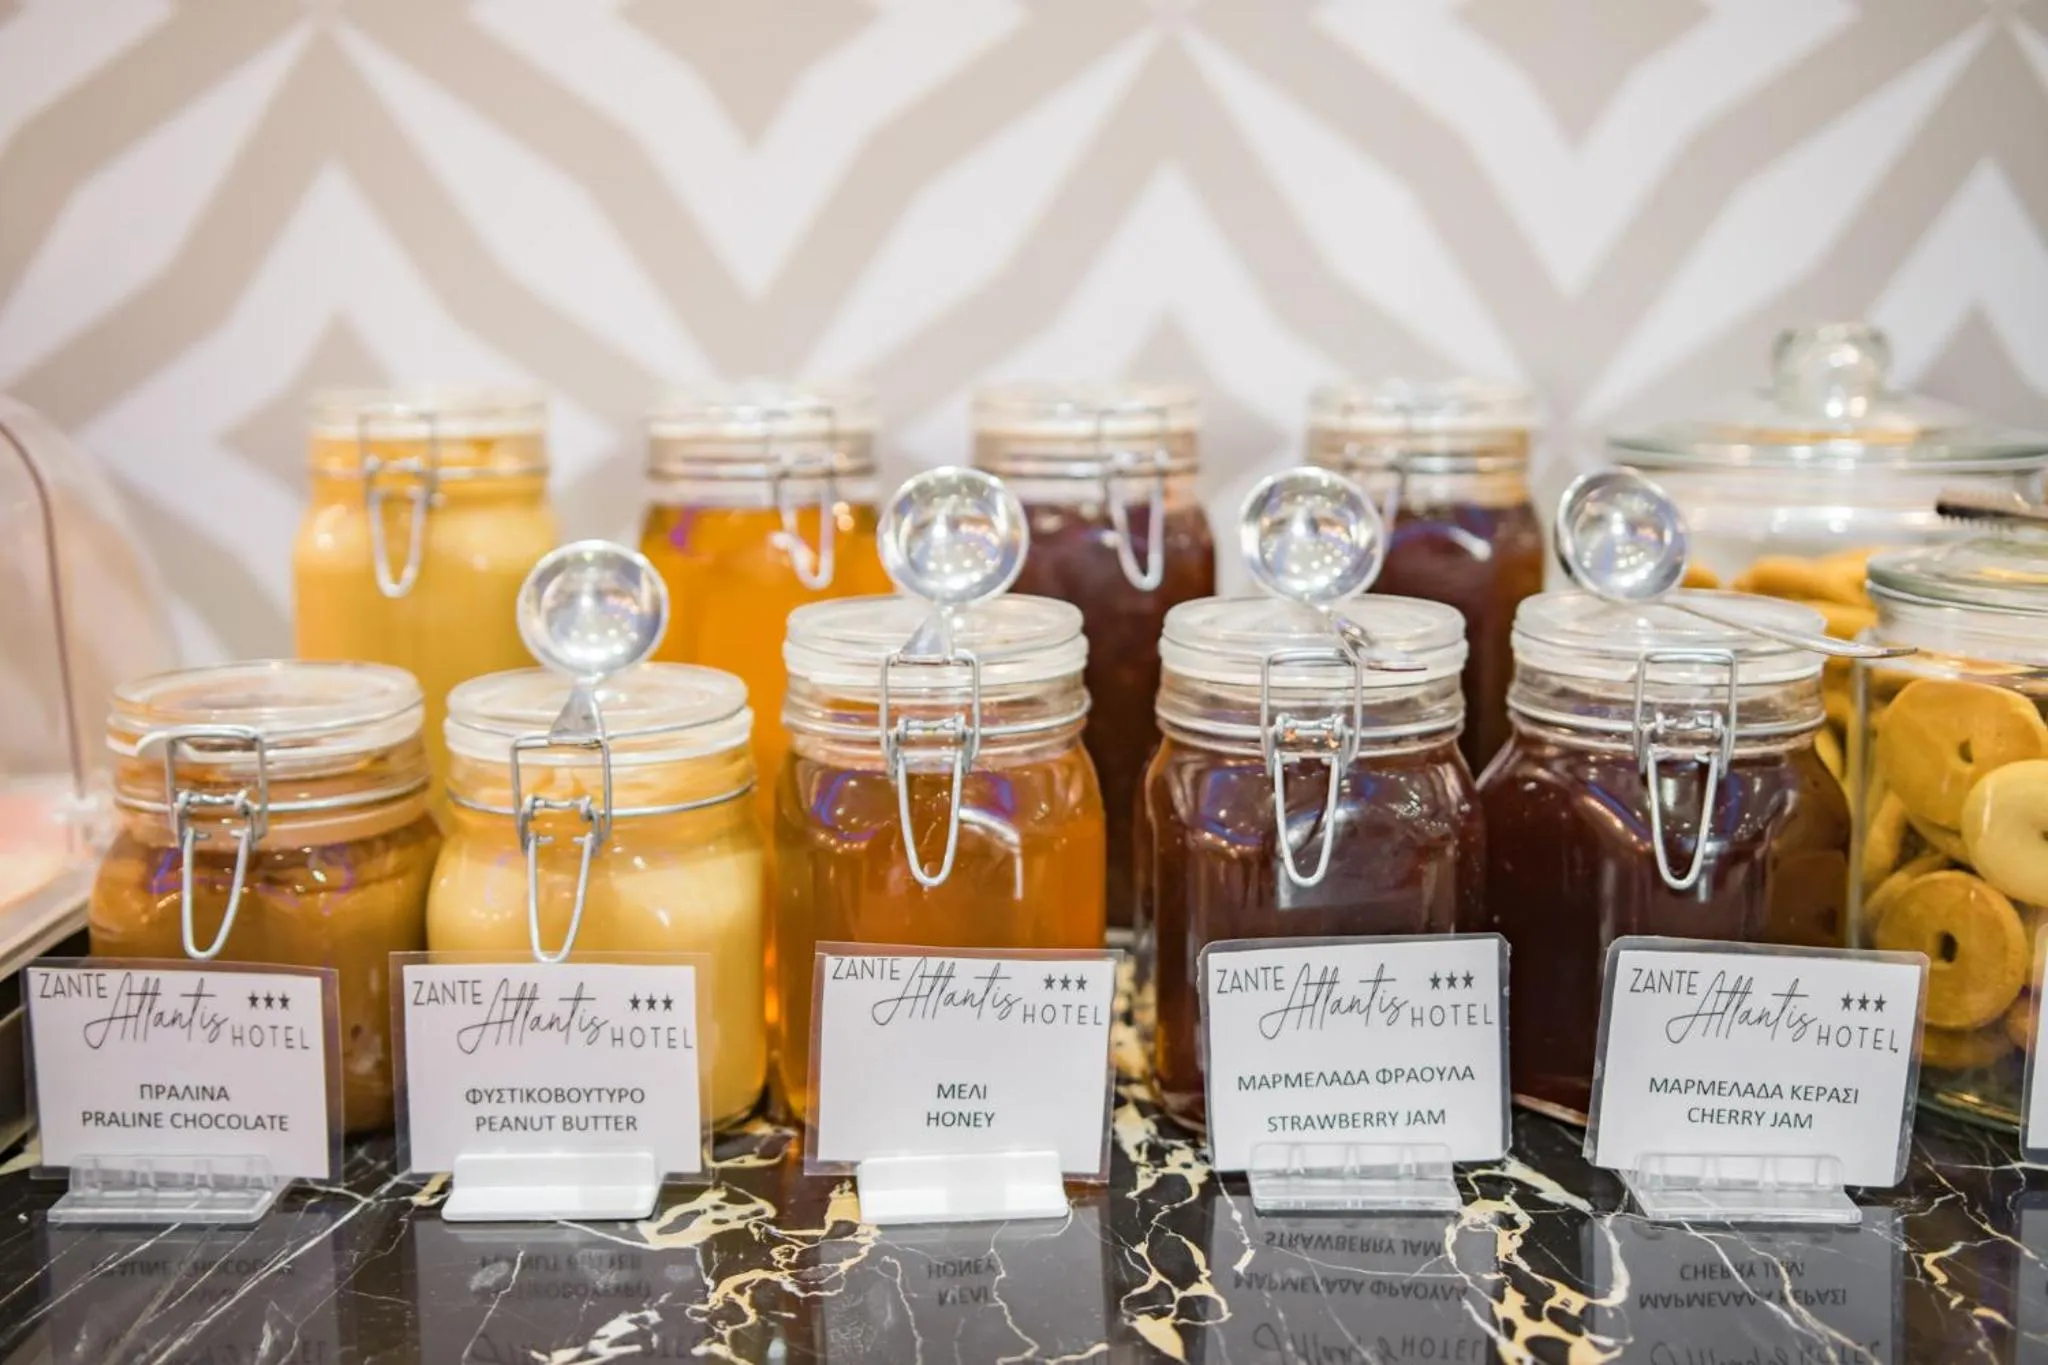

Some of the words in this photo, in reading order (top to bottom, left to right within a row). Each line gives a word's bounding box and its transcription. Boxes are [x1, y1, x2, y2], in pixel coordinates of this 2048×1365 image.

[832, 957, 901, 981] ZANTE
[872, 956, 1024, 1026] Atlantis
[1022, 1003, 1103, 1026] HOTEL
[1216, 966, 1286, 995] ZANTE
[1259, 962, 1409, 1040] Atlantis
[1410, 1004, 1494, 1028] HOTEL
[39, 972, 109, 999] ZANTE
[83, 972, 231, 1049] Atlantis
[231, 1025, 311, 1050] HOTEL
[412, 980, 483, 1006] ZANTE
[457, 978, 609, 1054] Atlantis
[611, 1026, 694, 1049] HOTEL
[1629, 968, 1700, 996] ZANTE
[1665, 970, 1818, 1044] Atlantis
[1237, 1069, 1370, 1092] ΜΑΡΜΕΛΑΔΑ
[1375, 1064, 1476, 1085] ΦΡΑΟΥΛΑ
[139, 1083, 231, 1102] ΠΡΑΛΙΝΑ
[465, 1087, 645, 1105] ΦΥΣΤΙΚΟΒΟΥΤΥΡΟ
[937, 1083, 988, 1100] ΜΕΛΙ
[1648, 1077, 1784, 1100] ΜΑΡΜΕΛΑΔΑ
[1789, 1083, 1859, 1105] ΚΕΡΑΣΙ
[81, 1110, 164, 1129] PRALINE
[170, 1112, 290, 1131] CHOCOLATE
[475, 1115, 556, 1131] PEANUT
[561, 1115, 638, 1131] BUTTER
[926, 1110, 996, 1128] HONEY
[1267, 1110, 1400, 1133] STRAWBERRY
[1405, 1109, 1447, 1127] JAM
[1686, 1106, 1765, 1126] CHERRY
[1770, 1112, 1814, 1130] JAM
